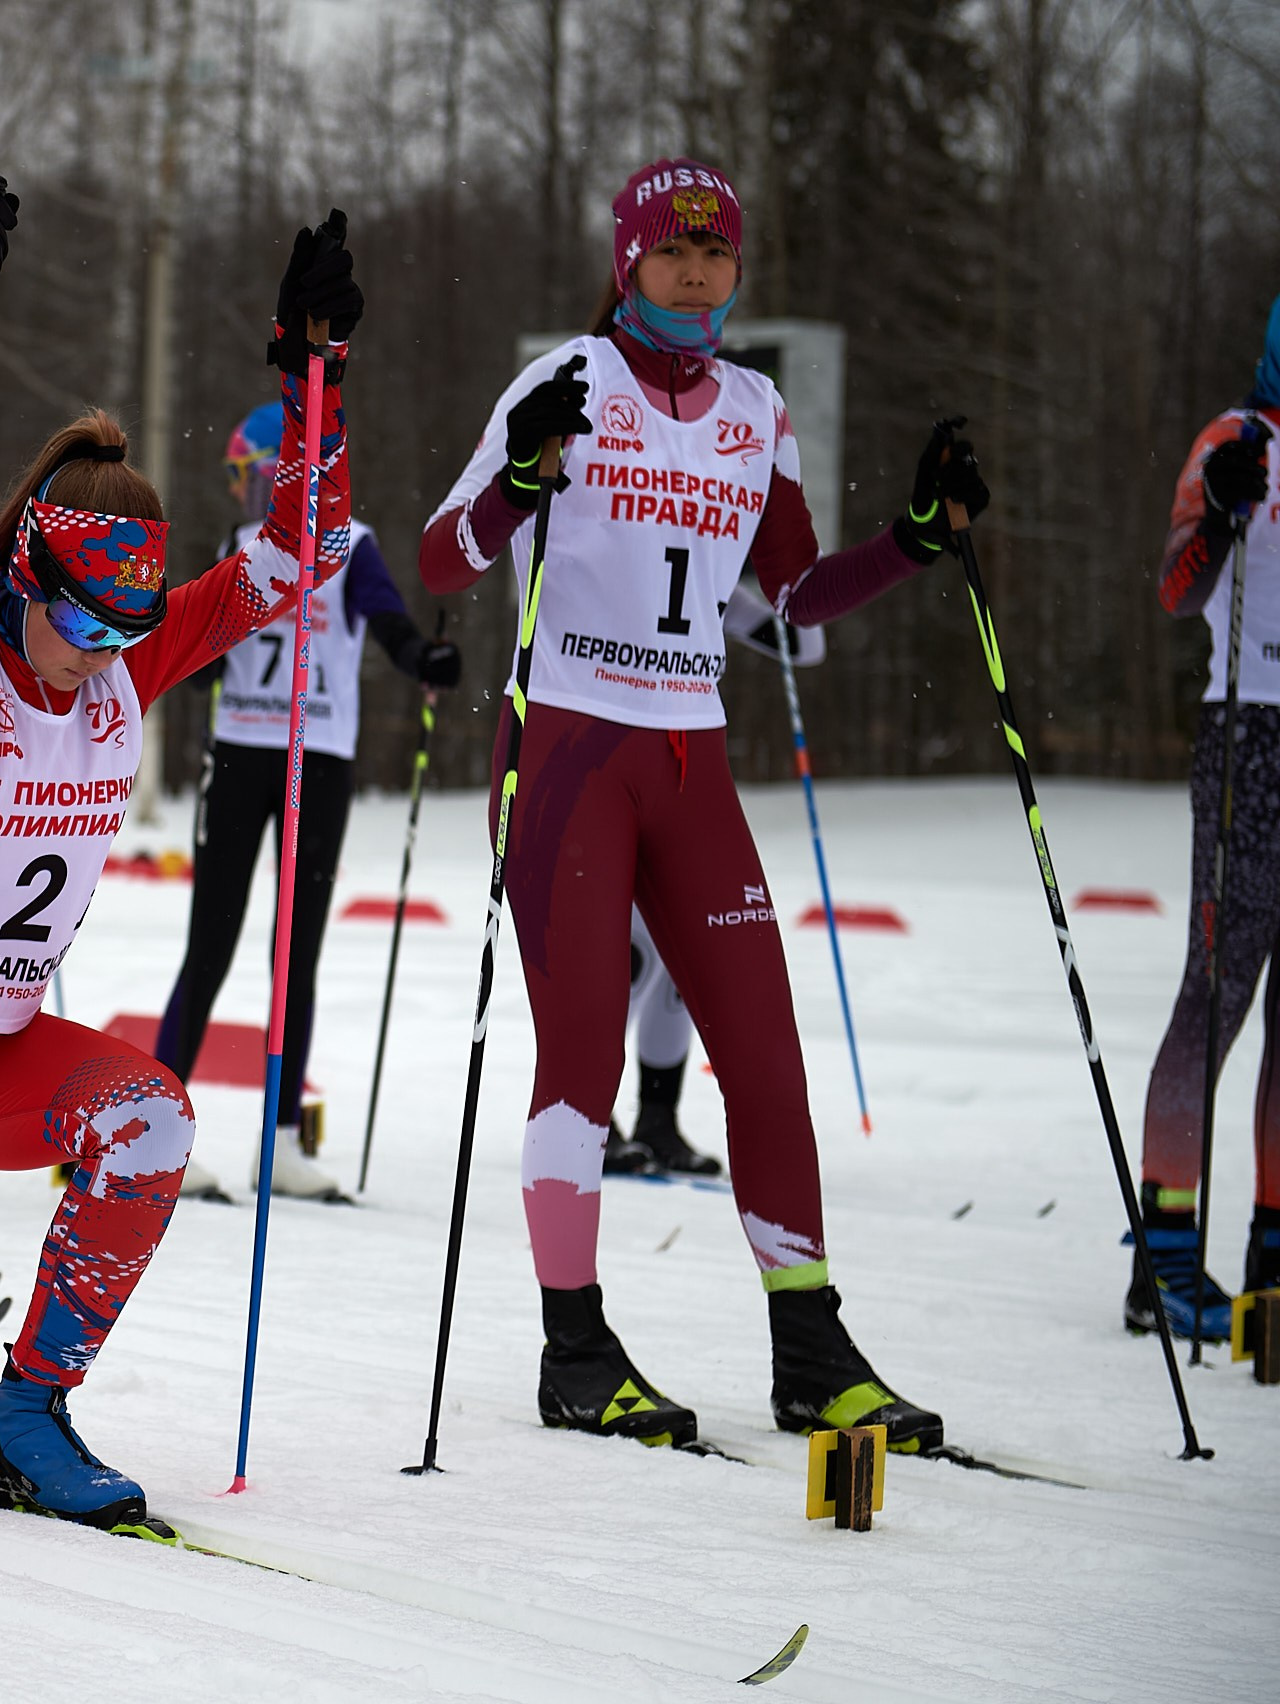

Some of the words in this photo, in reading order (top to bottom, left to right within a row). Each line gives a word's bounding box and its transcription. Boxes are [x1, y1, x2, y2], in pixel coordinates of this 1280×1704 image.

[598, 435, 644, 454] КПРФ
[717, 418, 753, 444] 70
[586, 463, 764, 516] ПИОНЕРСКАЯ
[610, 492, 740, 541] ПРАВДА
[657, 546, 691, 636] 1
[258, 634, 284, 688] 7
[561, 632, 726, 678] ПЕРВОУРАЛЬСК-2
[595, 667, 657, 692] Пионерка
[85, 698, 121, 729] 70
